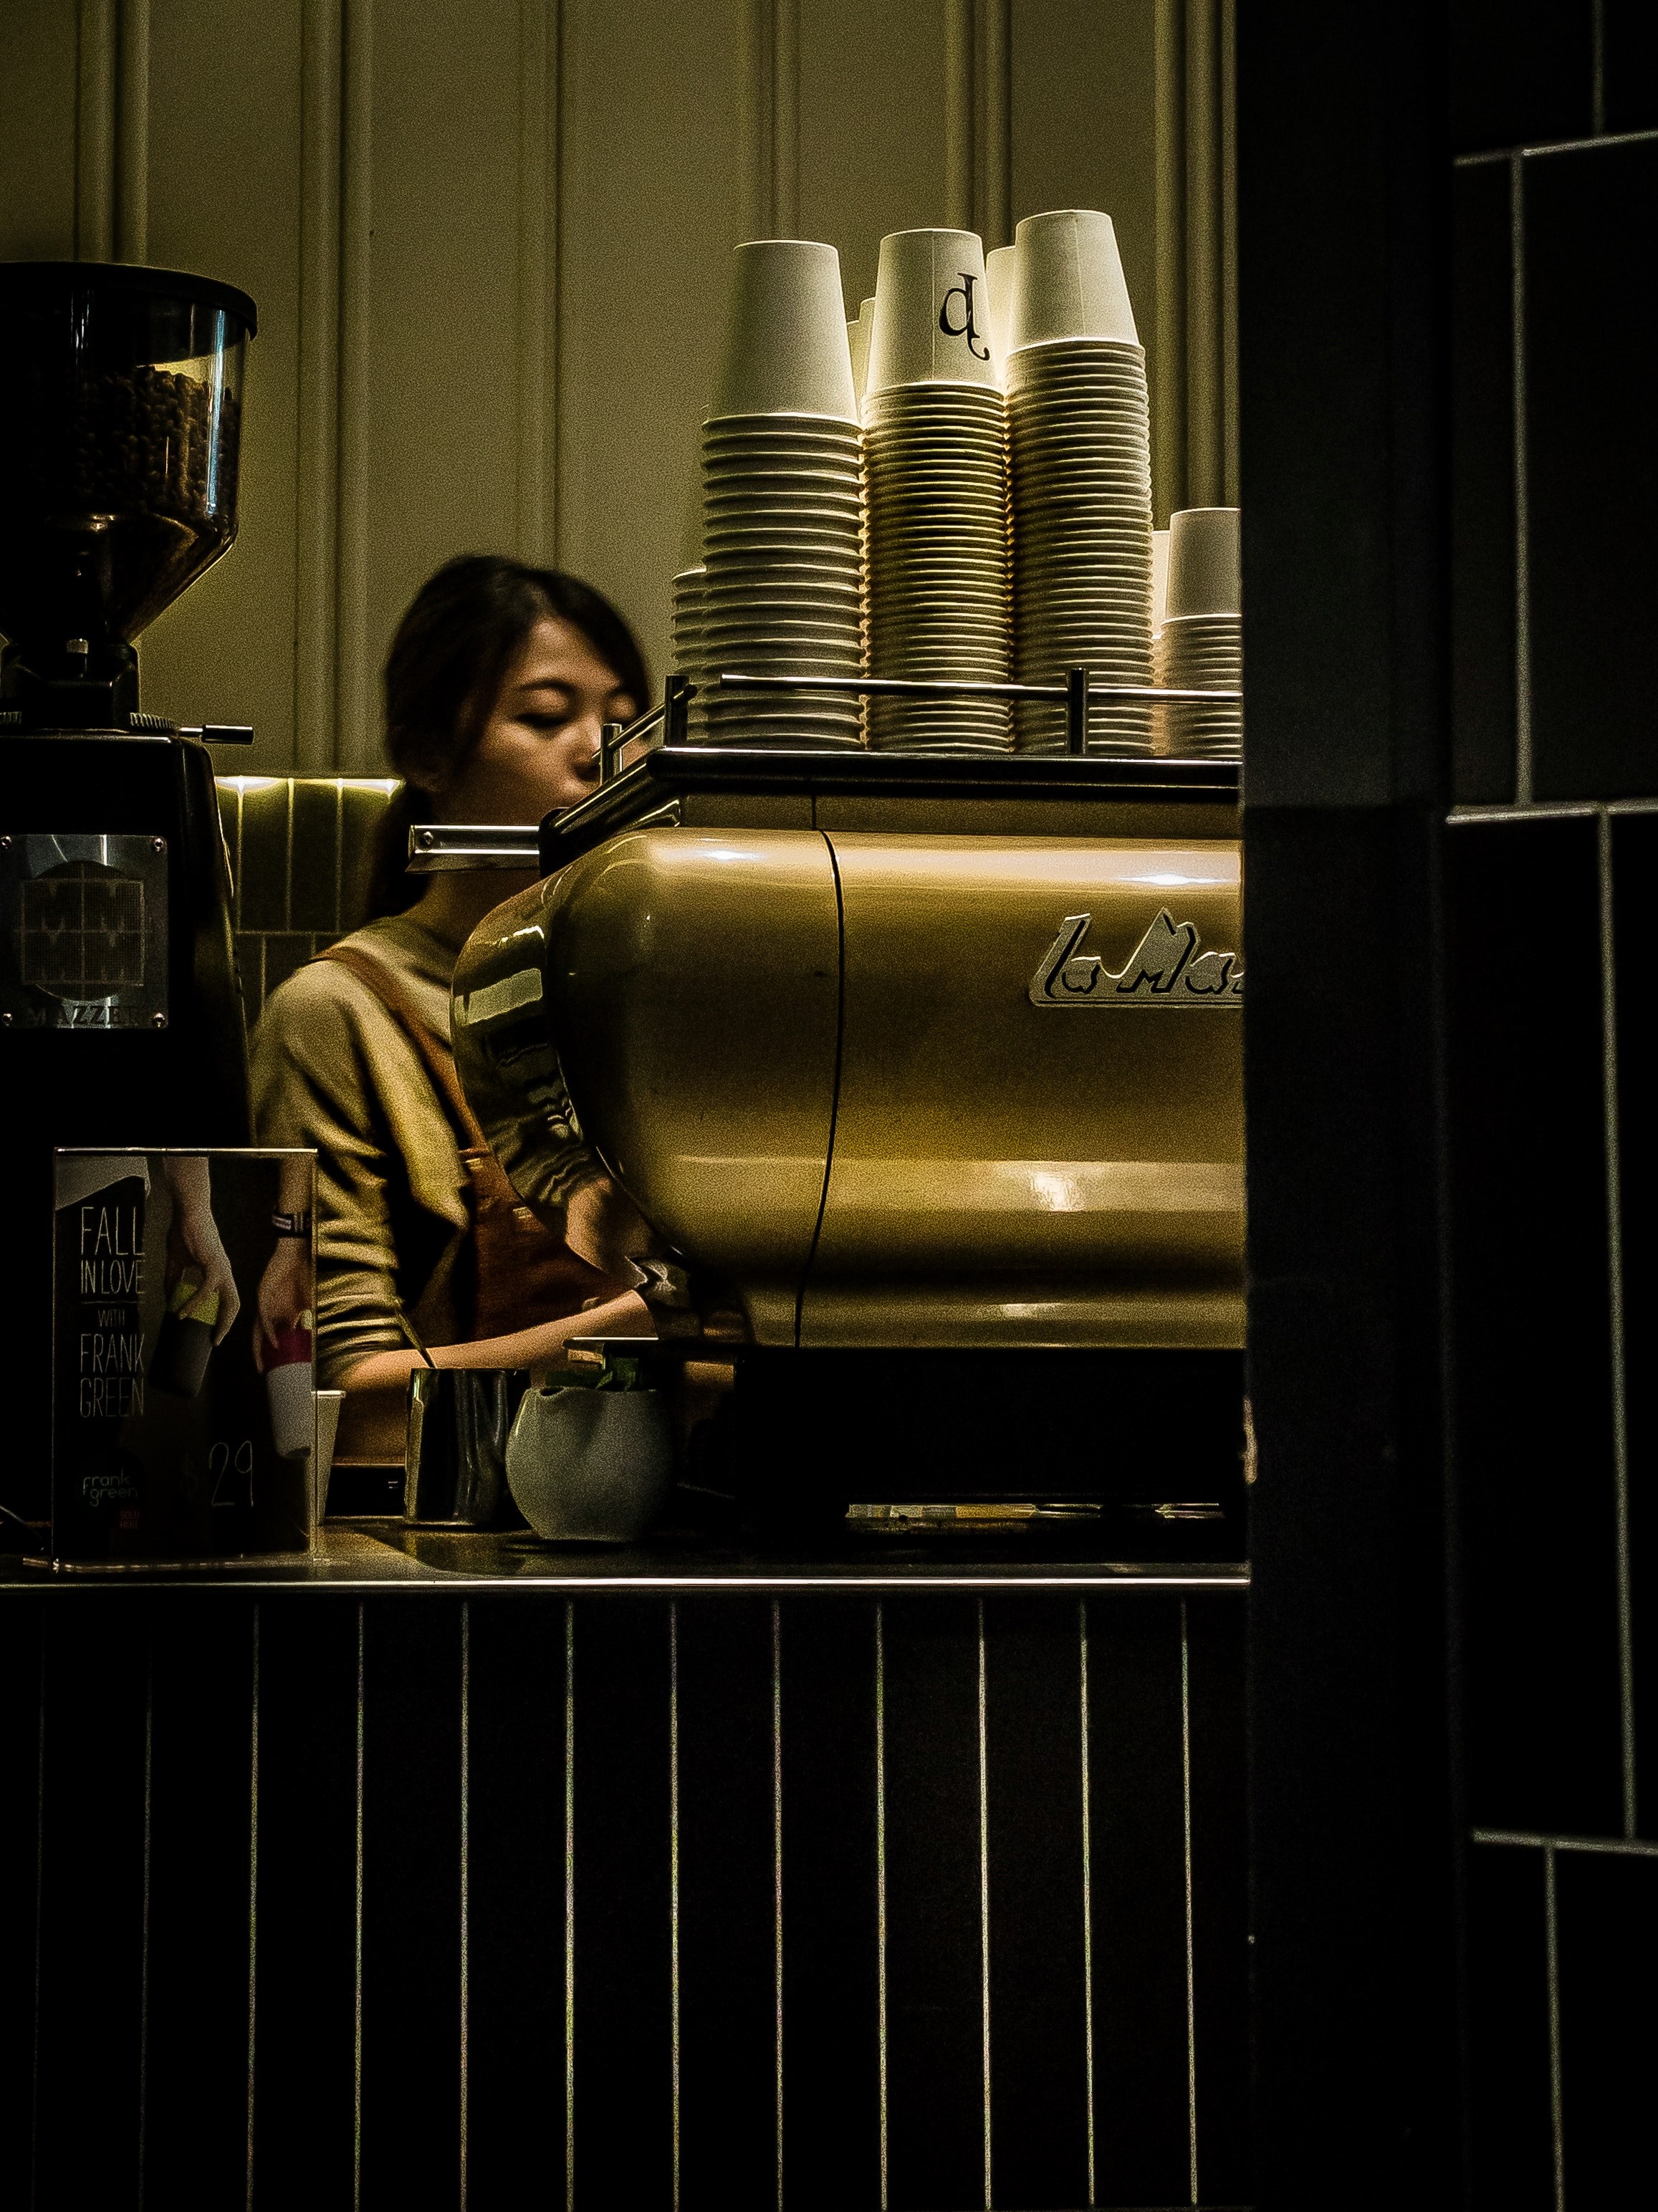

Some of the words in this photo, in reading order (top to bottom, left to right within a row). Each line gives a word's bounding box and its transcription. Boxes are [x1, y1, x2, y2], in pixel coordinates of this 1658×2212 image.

[80, 1206, 145, 1256] FALL
[80, 1259, 97, 1294] IN
[101, 1259, 145, 1294] LOVE
[97, 1306, 125, 1327] WITH
[80, 1333, 145, 1374] FRANK
[80, 1377, 145, 1418] GREEN
[82, 1468, 131, 1496] frank
[89, 1485, 138, 1508] green
